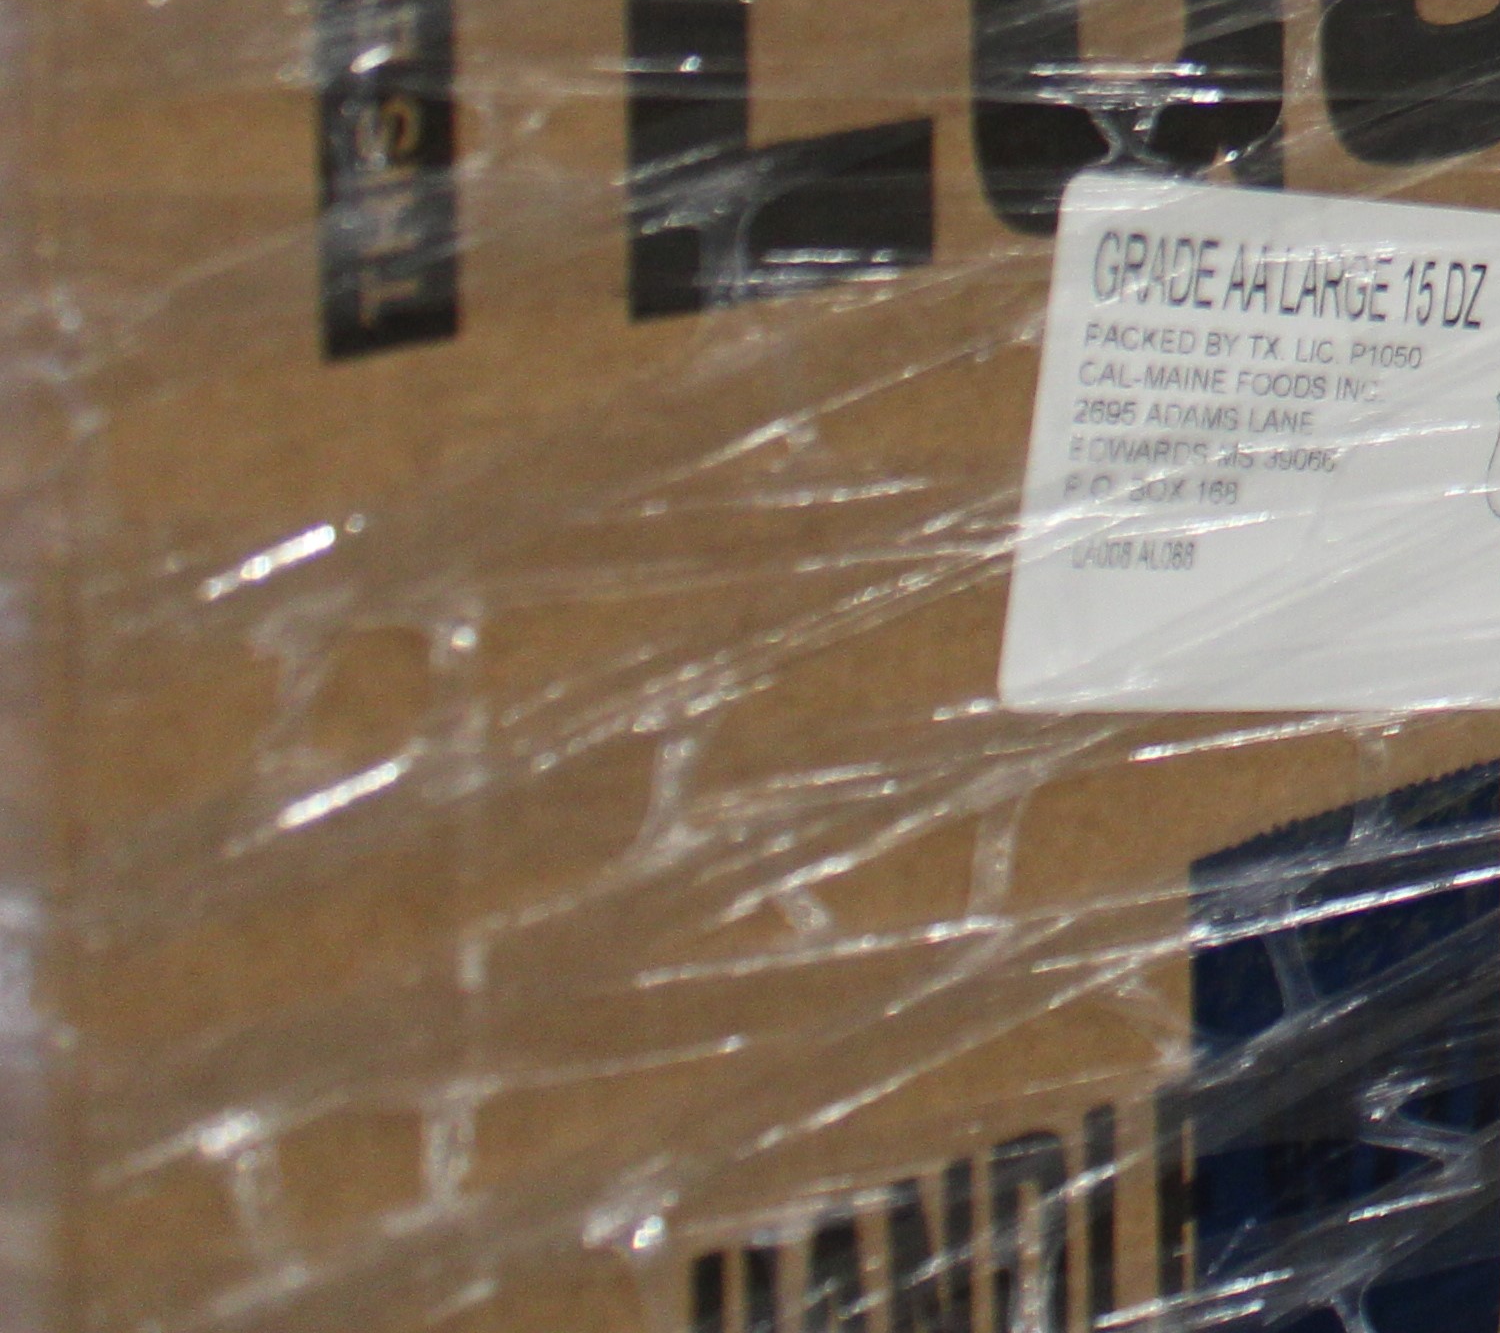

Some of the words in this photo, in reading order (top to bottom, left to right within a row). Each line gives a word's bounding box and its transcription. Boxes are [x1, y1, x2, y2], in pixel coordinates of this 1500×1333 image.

[1093, 231, 1220, 307] GRADE
[1223, 243, 1268, 314] AA
[1278, 244, 1393, 322] LARGE
[1403, 260, 1436, 326] 15
[1441, 261, 1488, 331] DZ
[1085, 322, 1196, 354] PACKED
[1205, 331, 1240, 357] BY
[1350, 341, 1423, 370] P1050
[1078, 360, 1228, 394] CAL-MAINE
[1236, 369, 1327, 400] FOODS
[1144, 402, 1240, 432] ADAMS
[1248, 408, 1315, 435] LANE
